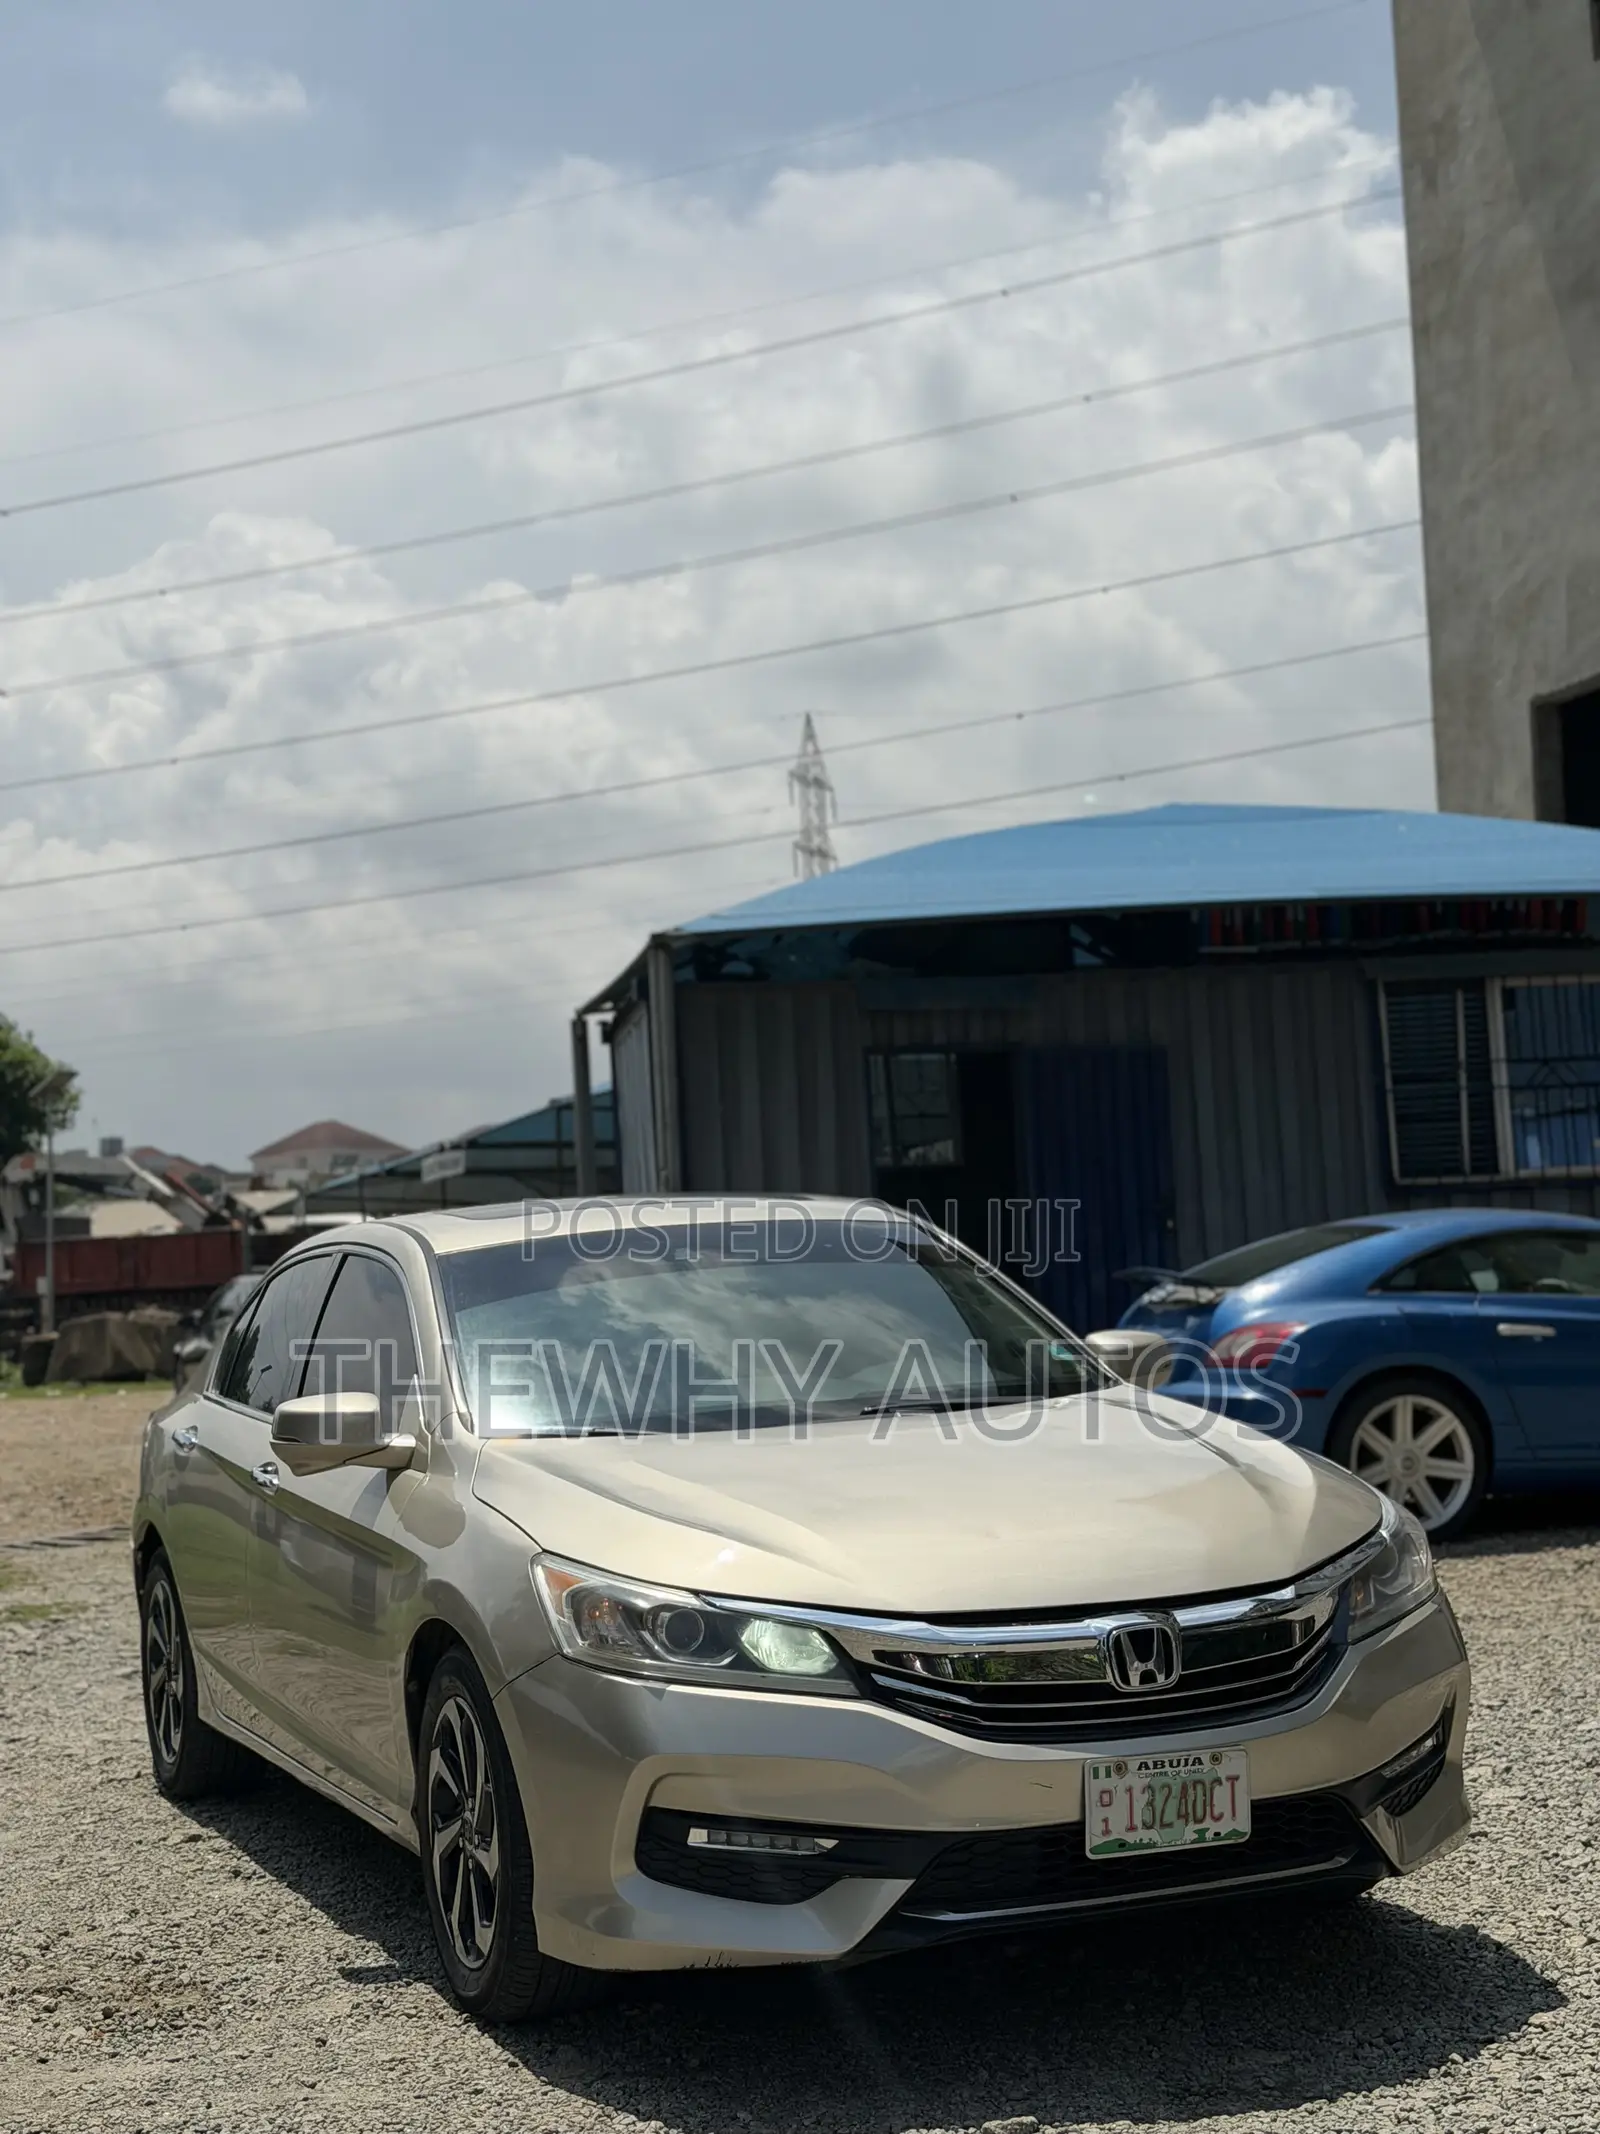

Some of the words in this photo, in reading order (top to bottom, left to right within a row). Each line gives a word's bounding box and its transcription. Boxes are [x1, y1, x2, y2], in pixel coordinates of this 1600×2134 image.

[1136, 1756, 1205, 1771] ABUJA
[1138, 1770, 1169, 1779] CENTRE
[1171, 1769, 1182, 1777] OF
